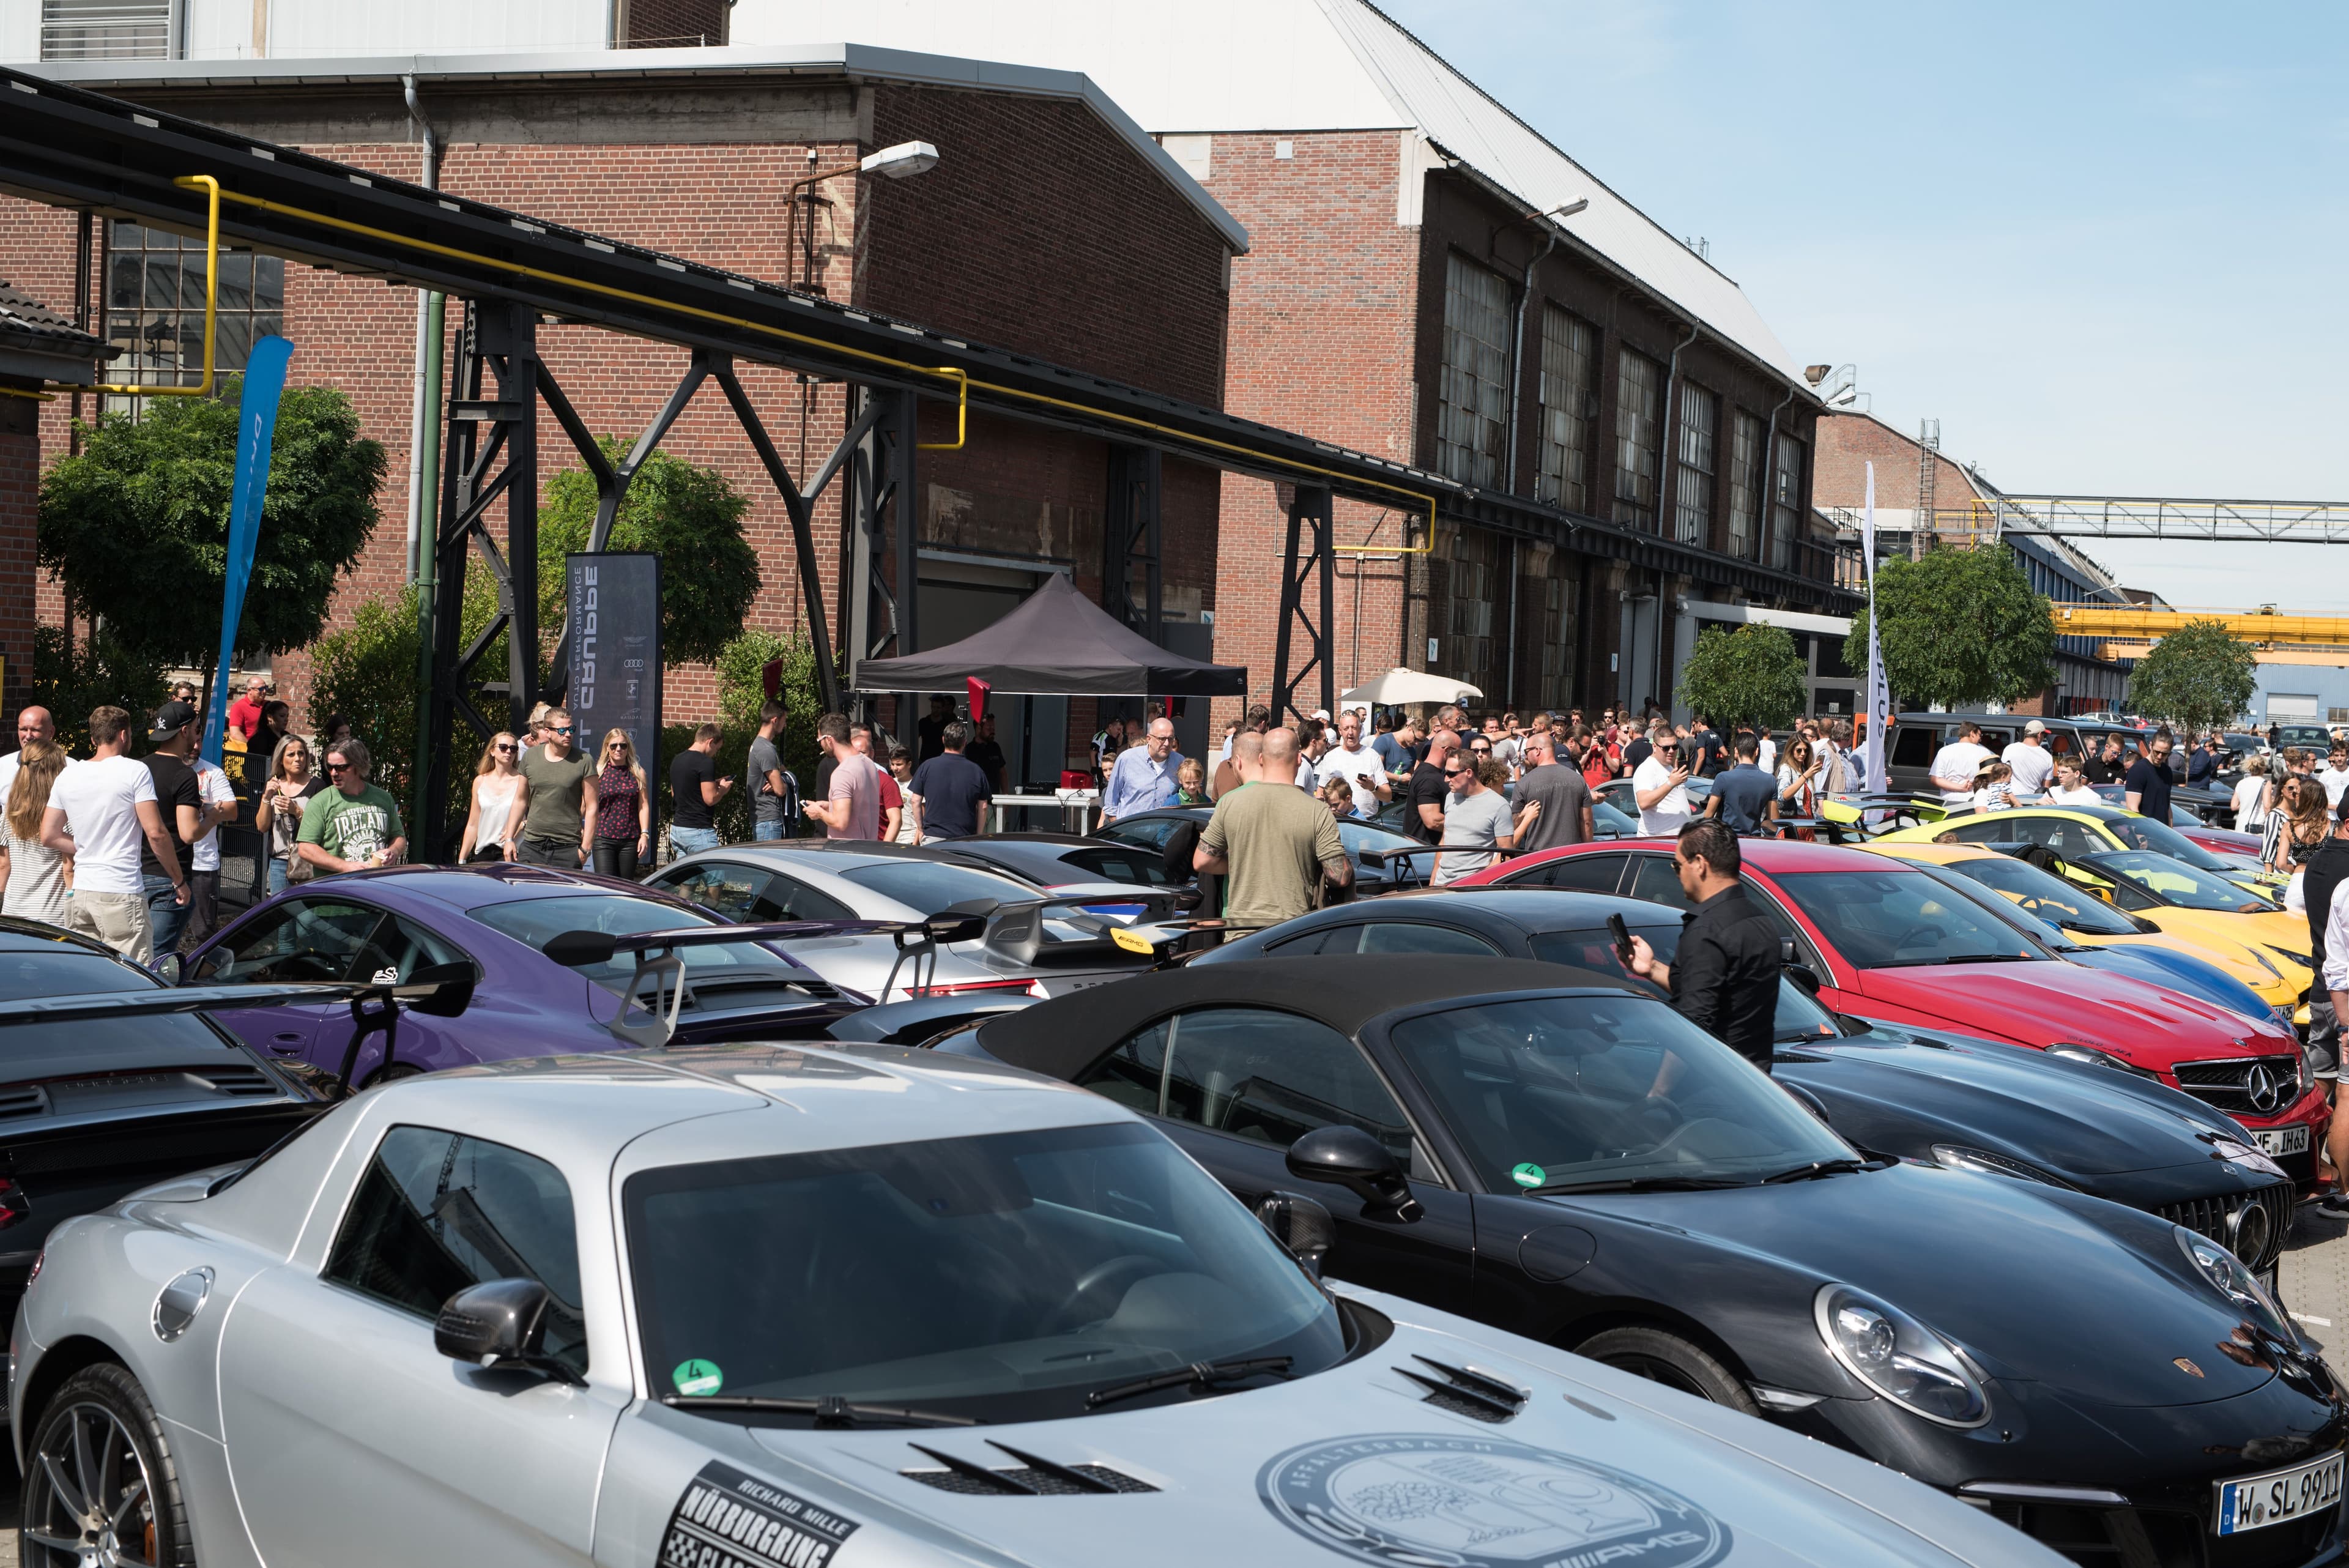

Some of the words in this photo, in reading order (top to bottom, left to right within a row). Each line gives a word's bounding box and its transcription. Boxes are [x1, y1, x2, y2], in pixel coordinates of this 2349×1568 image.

[334, 812, 388, 844] IRELAND
[689, 1361, 703, 1378] 4
[1289, 1440, 1492, 1489] AFFALTERBACH
[738, 1479, 803, 1514] RICHARD
[801, 1507, 850, 1536] MILLE
[2239, 1485, 2254, 1525] W
[2268, 1479, 2295, 1518] SL
[2301, 1462, 2339, 1510] 9911
[680, 1485, 829, 1568] NÜRBURGRING
